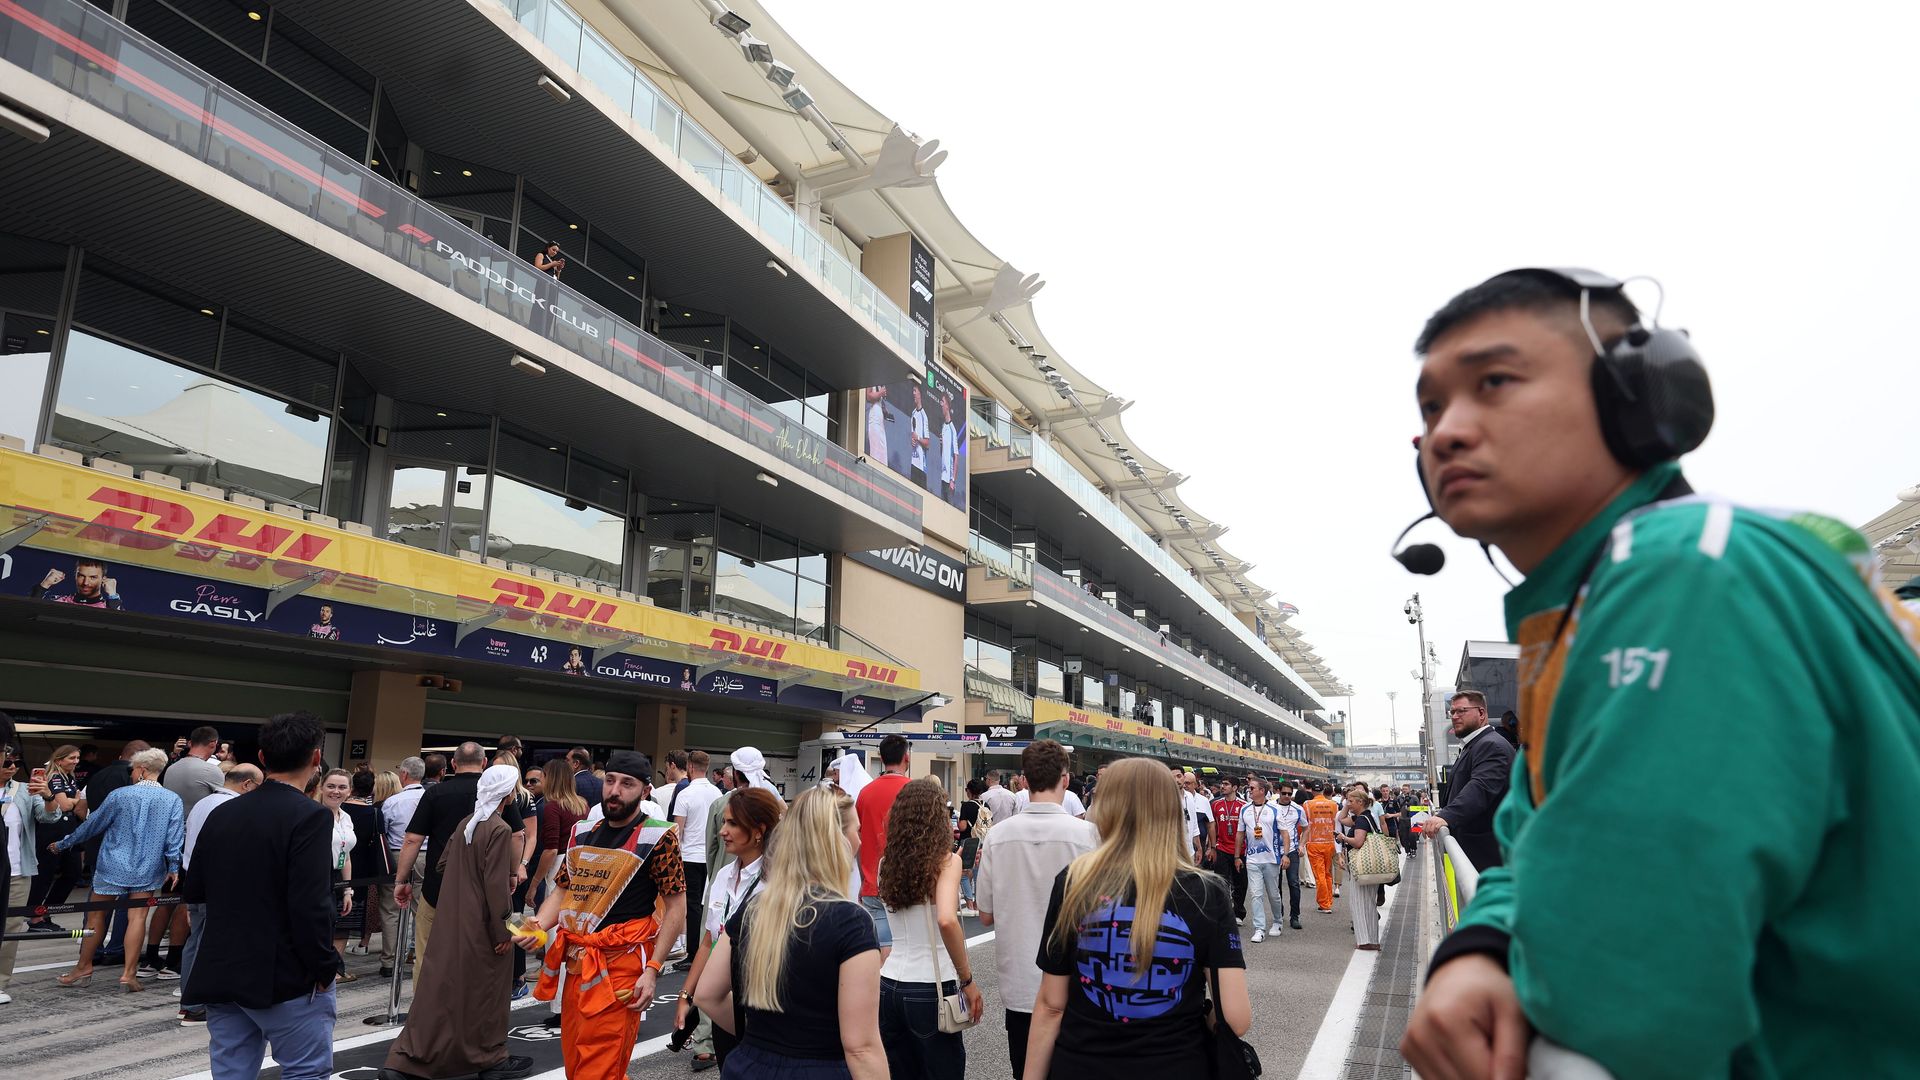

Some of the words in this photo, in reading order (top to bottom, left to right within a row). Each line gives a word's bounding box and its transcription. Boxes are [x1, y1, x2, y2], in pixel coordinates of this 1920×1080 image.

[436, 240, 547, 310] PADDOCK
[549, 304, 599, 338] CLUB
[75, 487, 332, 562] DHL
[937, 563, 964, 592] ON
[196, 585, 240, 604] Pierre
[490, 578, 618, 624] DHL
[170, 599, 263, 622] GASLY
[531, 645, 548, 662] 43
[708, 628, 787, 660] DHL
[597, 665, 671, 684] COLAPINTO
[845, 660, 899, 683] DHL
[1599, 646, 1671, 690] 157
[1069, 710, 1090, 725] DHL
[988, 726, 1018, 738] YAS
[352, 743, 365, 754] 25
